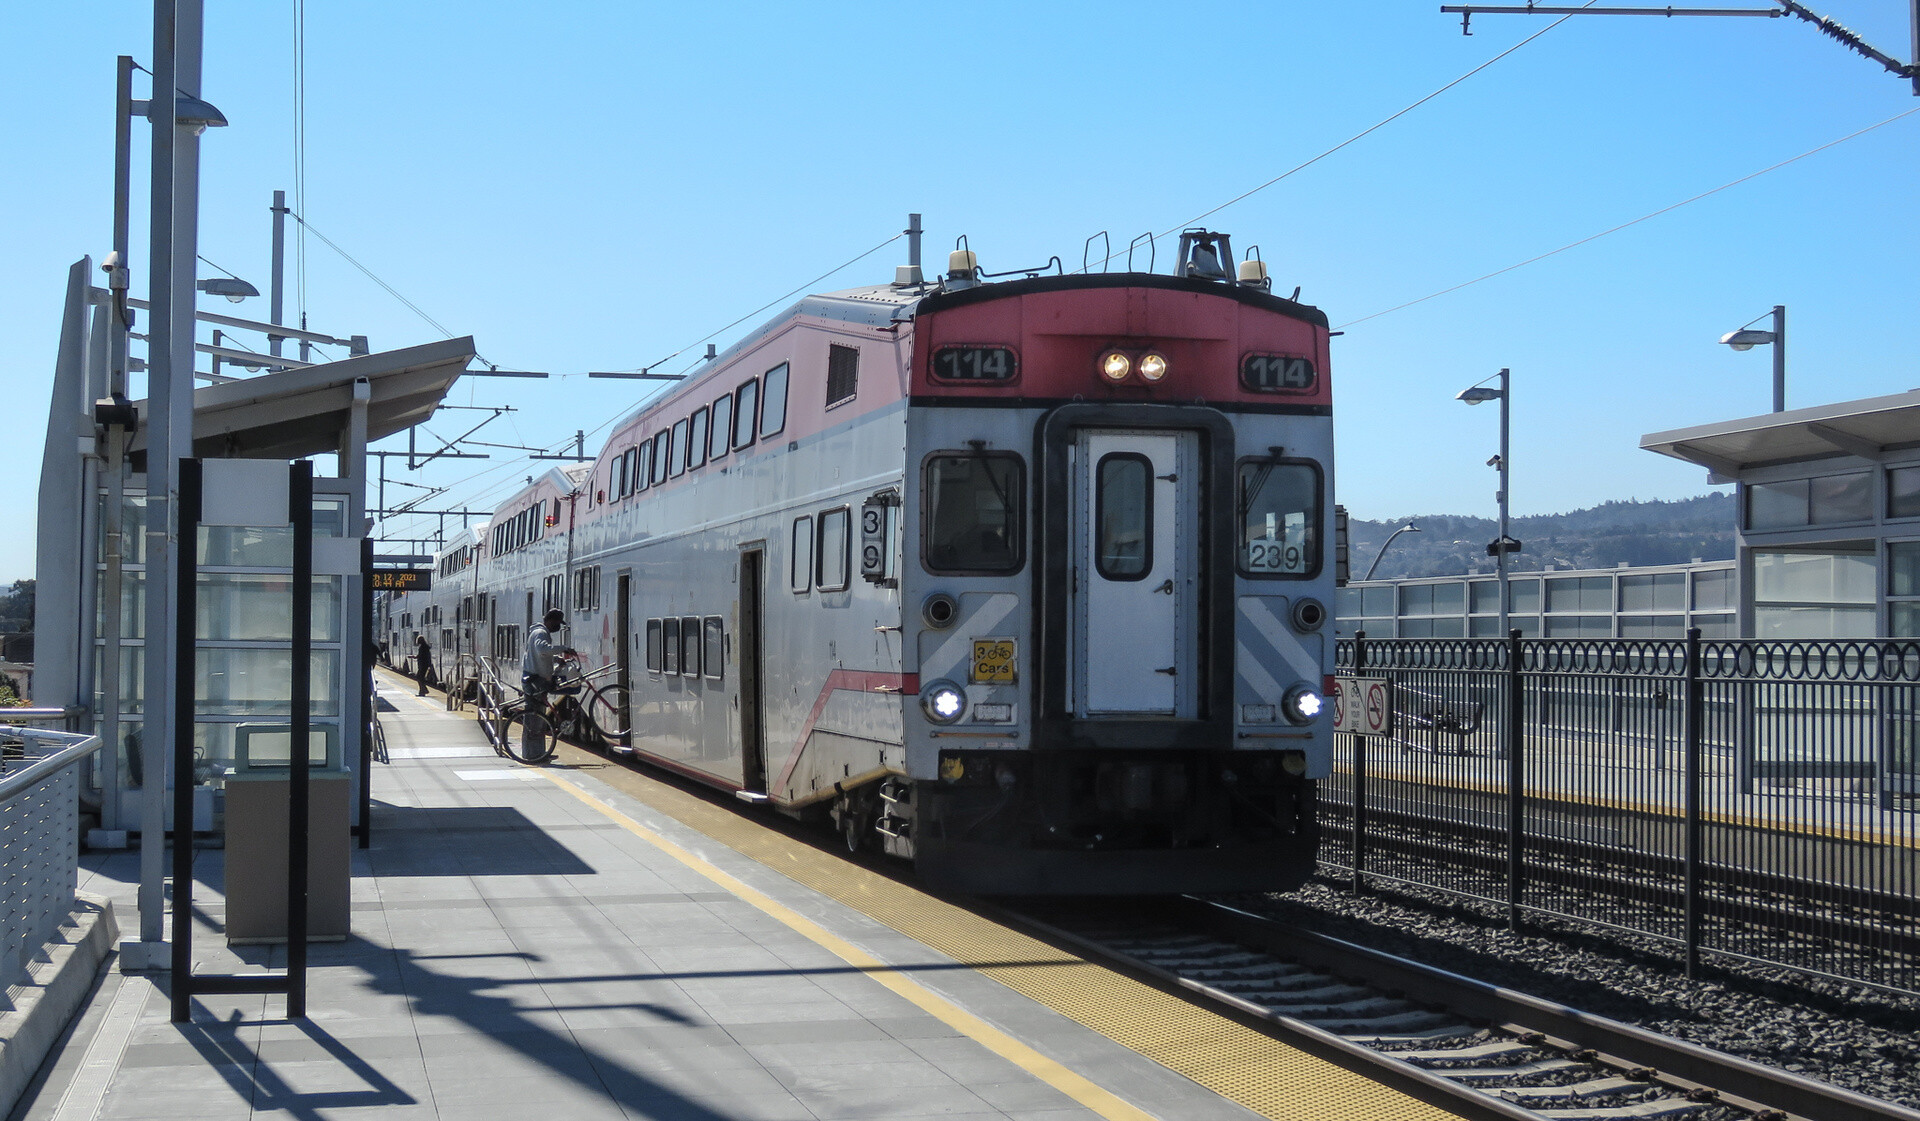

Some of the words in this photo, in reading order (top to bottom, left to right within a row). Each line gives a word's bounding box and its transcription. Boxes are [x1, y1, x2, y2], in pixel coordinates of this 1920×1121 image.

[942, 350, 1007, 378] 114
[1251, 357, 1307, 388] 114
[1251, 544, 1299, 570] 239
[399, 573, 416, 581] 2021
[395, 580, 405, 588] AM
[977, 646, 985, 659] 3
[979, 662, 1009, 674] Cars
